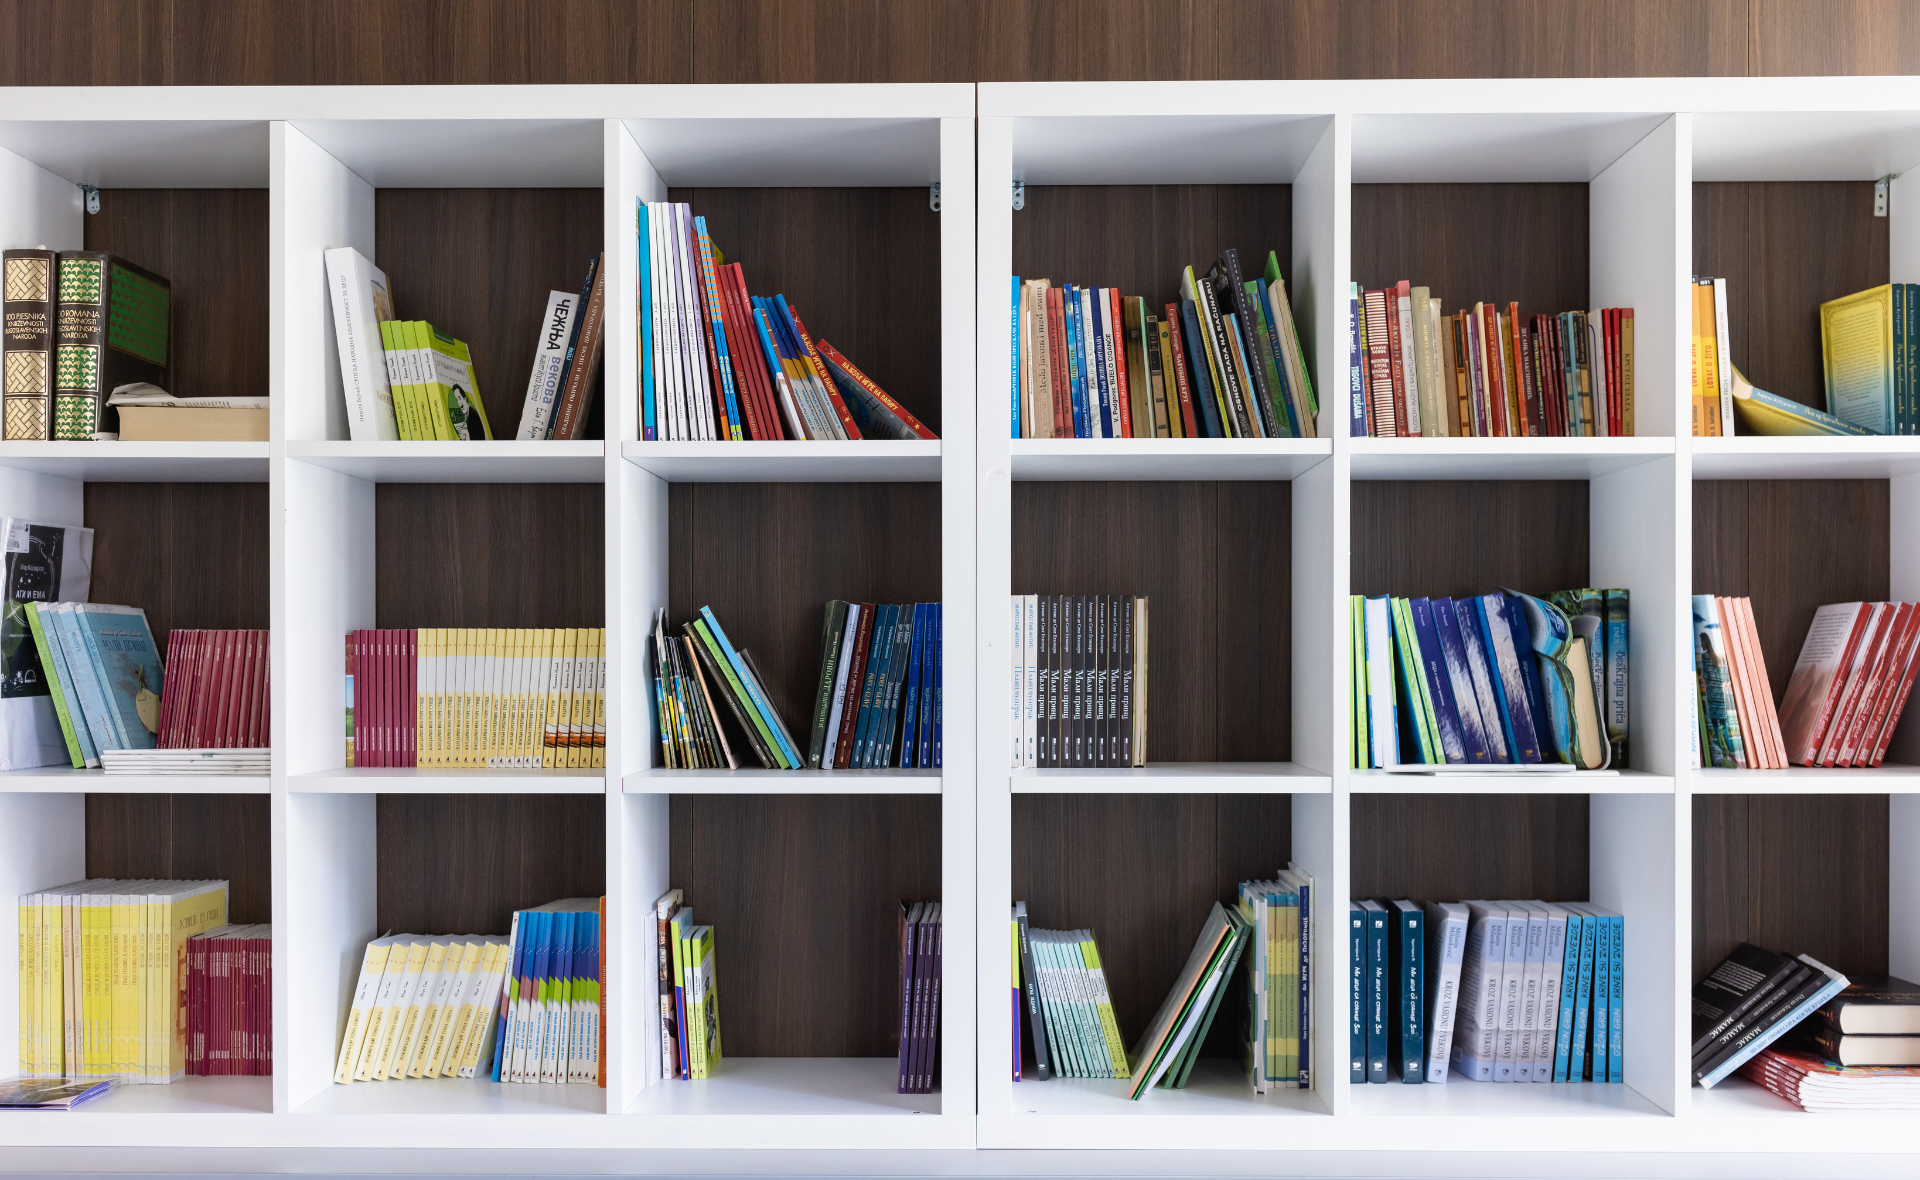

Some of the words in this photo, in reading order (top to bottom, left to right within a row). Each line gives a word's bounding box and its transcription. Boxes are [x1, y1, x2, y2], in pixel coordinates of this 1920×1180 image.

[66, 309, 100, 318] ROMANA
[1205, 281, 1223, 332] RAČUNARU
[547, 299, 571, 350] ЧЕЖЊА
[1218, 332, 1226, 346] NA
[1038, 339, 1048, 367] javom
[1222, 346, 1233, 372] RADA
[1350, 366, 1361, 391] TRGOVCI
[1523, 356, 1532, 400] МАКСИМОВИЋ
[1624, 374, 1630, 386] ОД
[1706, 369, 1715, 389] LOVAC
[874, 389, 881, 397] НА
[1230, 374, 1243, 411] OSNOVE
[822, 660, 834, 691] ДАРОВИ
[1051, 670, 1059, 692] Мали
[1063, 669, 1071, 692] Мали
[1075, 670, 1083, 693] Мали
[1087, 669, 1095, 692] Мали
[873, 691, 884, 709] GLAVE
[1613, 700, 1627, 724] priča
[1569, 923, 1579, 959] ZVEZDE
[1584, 923, 1594, 959] ZVEZDE
[1599, 922, 1607, 958] ZVEZDE
[1567, 961, 1576, 972] SU
[1583, 961, 1590, 972] SU
[1599, 961, 1606, 972] SU
[1613, 961, 1620, 972] SU
[1444, 980, 1454, 999] KROZ
[1487, 979, 1497, 998] KROZ
[1508, 980, 1517, 998] KROZ
[1565, 974, 1575, 998] KRIVE
[1581, 974, 1590, 998] KRIVE
[1440, 1001, 1451, 1030] VASIONU
[1485, 999, 1495, 1028] VASIONU
[1505, 1000, 1516, 1029] VASIONU
[1562, 1008, 1571, 1029] GRIN
[1578, 1008, 1587, 1029] GRIN
[1710, 1016, 1734, 1039] МАМАС
[1719, 1022, 1746, 1045] МАМАС
[1735, 1026, 1762, 1048] МАМАС
[1436, 1034, 1447, 1061] VEKOVE
[1483, 1032, 1492, 1058] VEKOVE
[1503, 1034, 1513, 1060] VEKOVE
